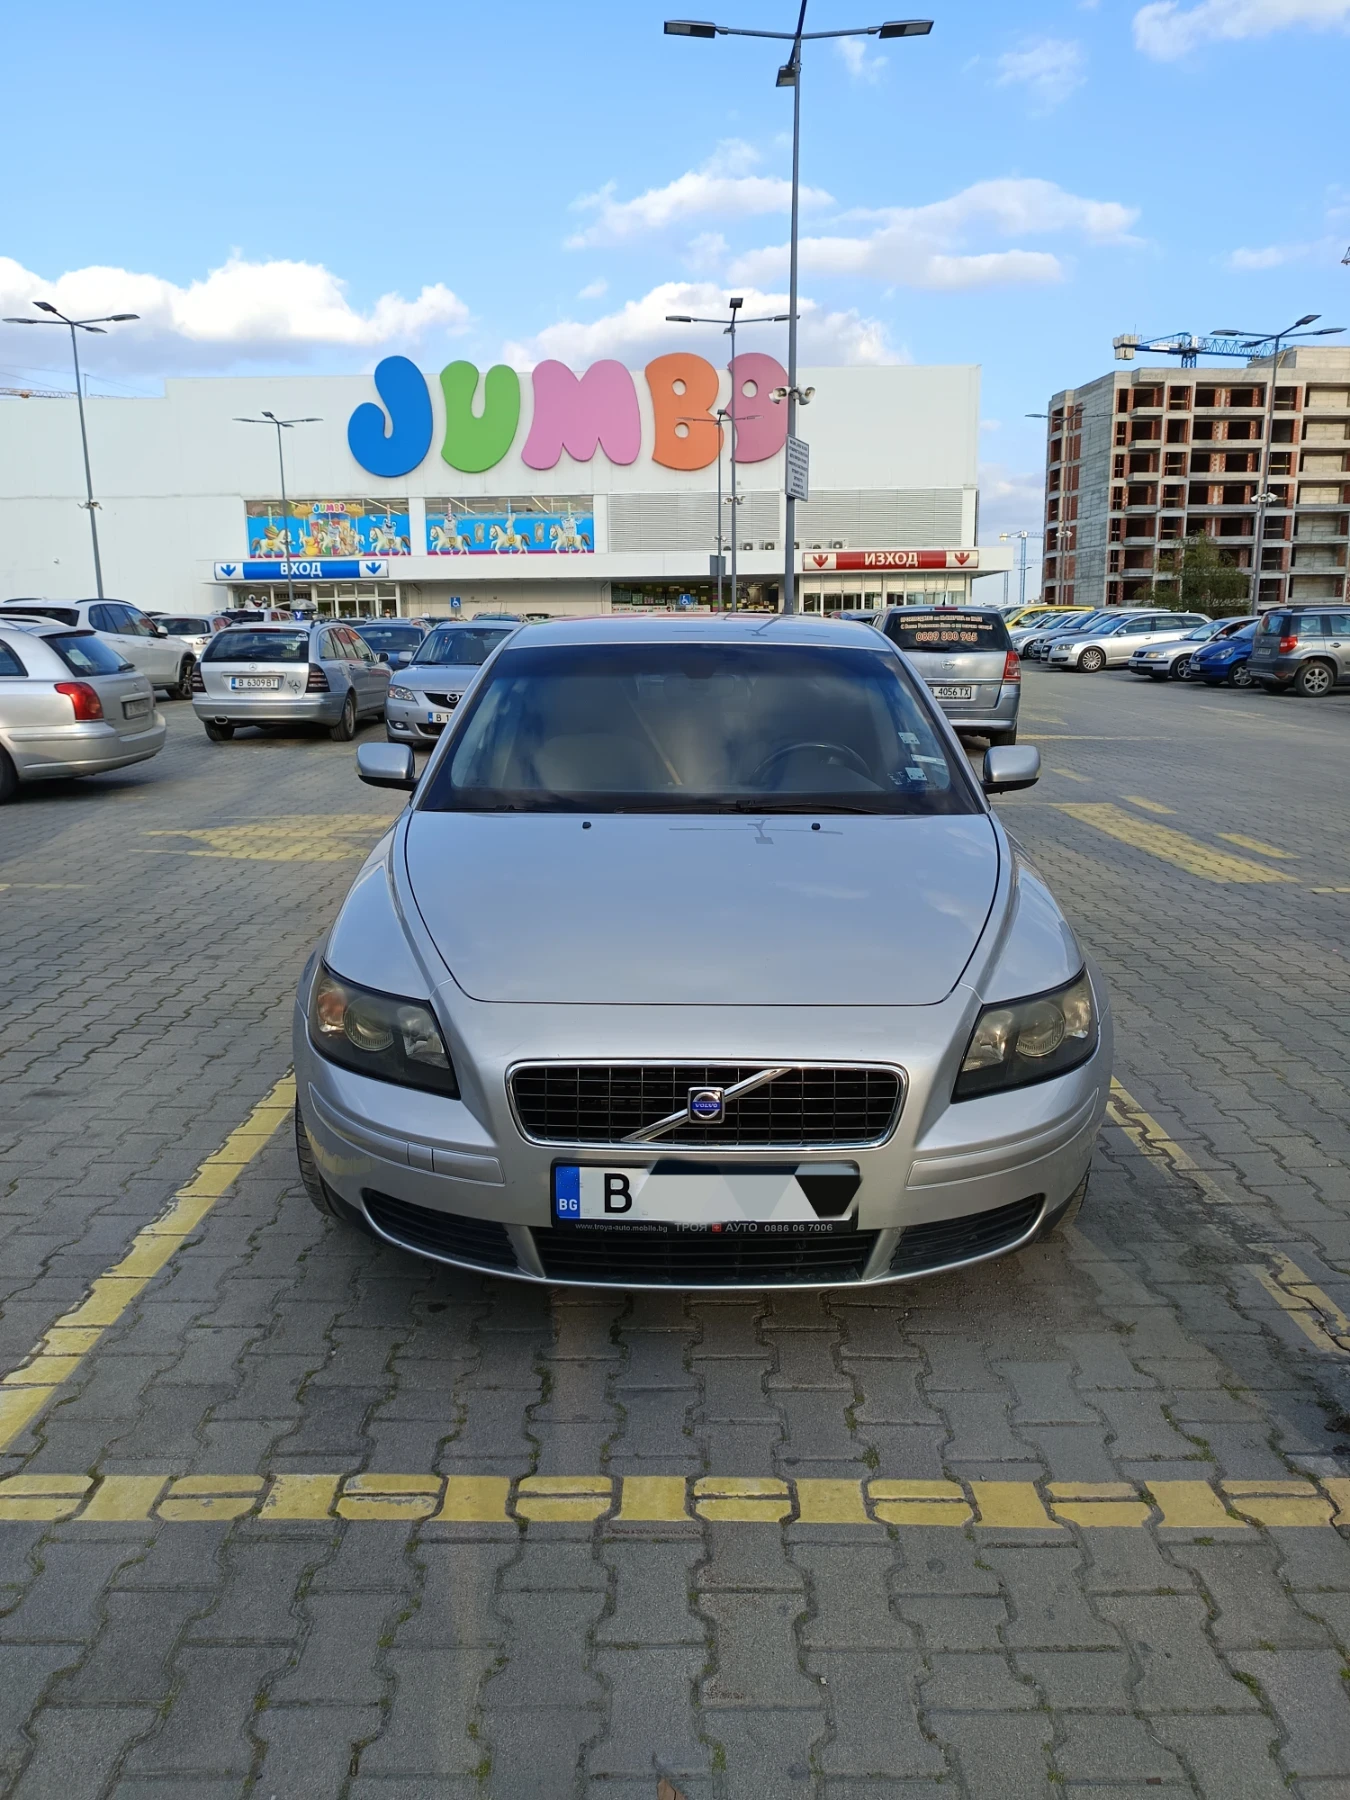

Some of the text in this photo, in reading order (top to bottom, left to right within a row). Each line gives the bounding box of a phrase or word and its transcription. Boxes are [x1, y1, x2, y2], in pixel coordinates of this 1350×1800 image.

[348, 352, 789, 477] JUMBO
[312, 502, 345, 514] JUMBO
[864, 552, 918, 567] ИЗХОД
[280, 562, 322, 577] ВХОД
[238, 679, 244, 687] B
[247, 679, 265, 687] 6309
[938, 687, 957, 696] 4056
[959, 687, 970, 696] TX
[604, 1173, 633, 1213] B
[559, 1199, 578, 1211] BG
[575, 1222, 833, 1233] www.troya-auto.mobile.bg ТРОЯ АУТО 0886 06 7006
